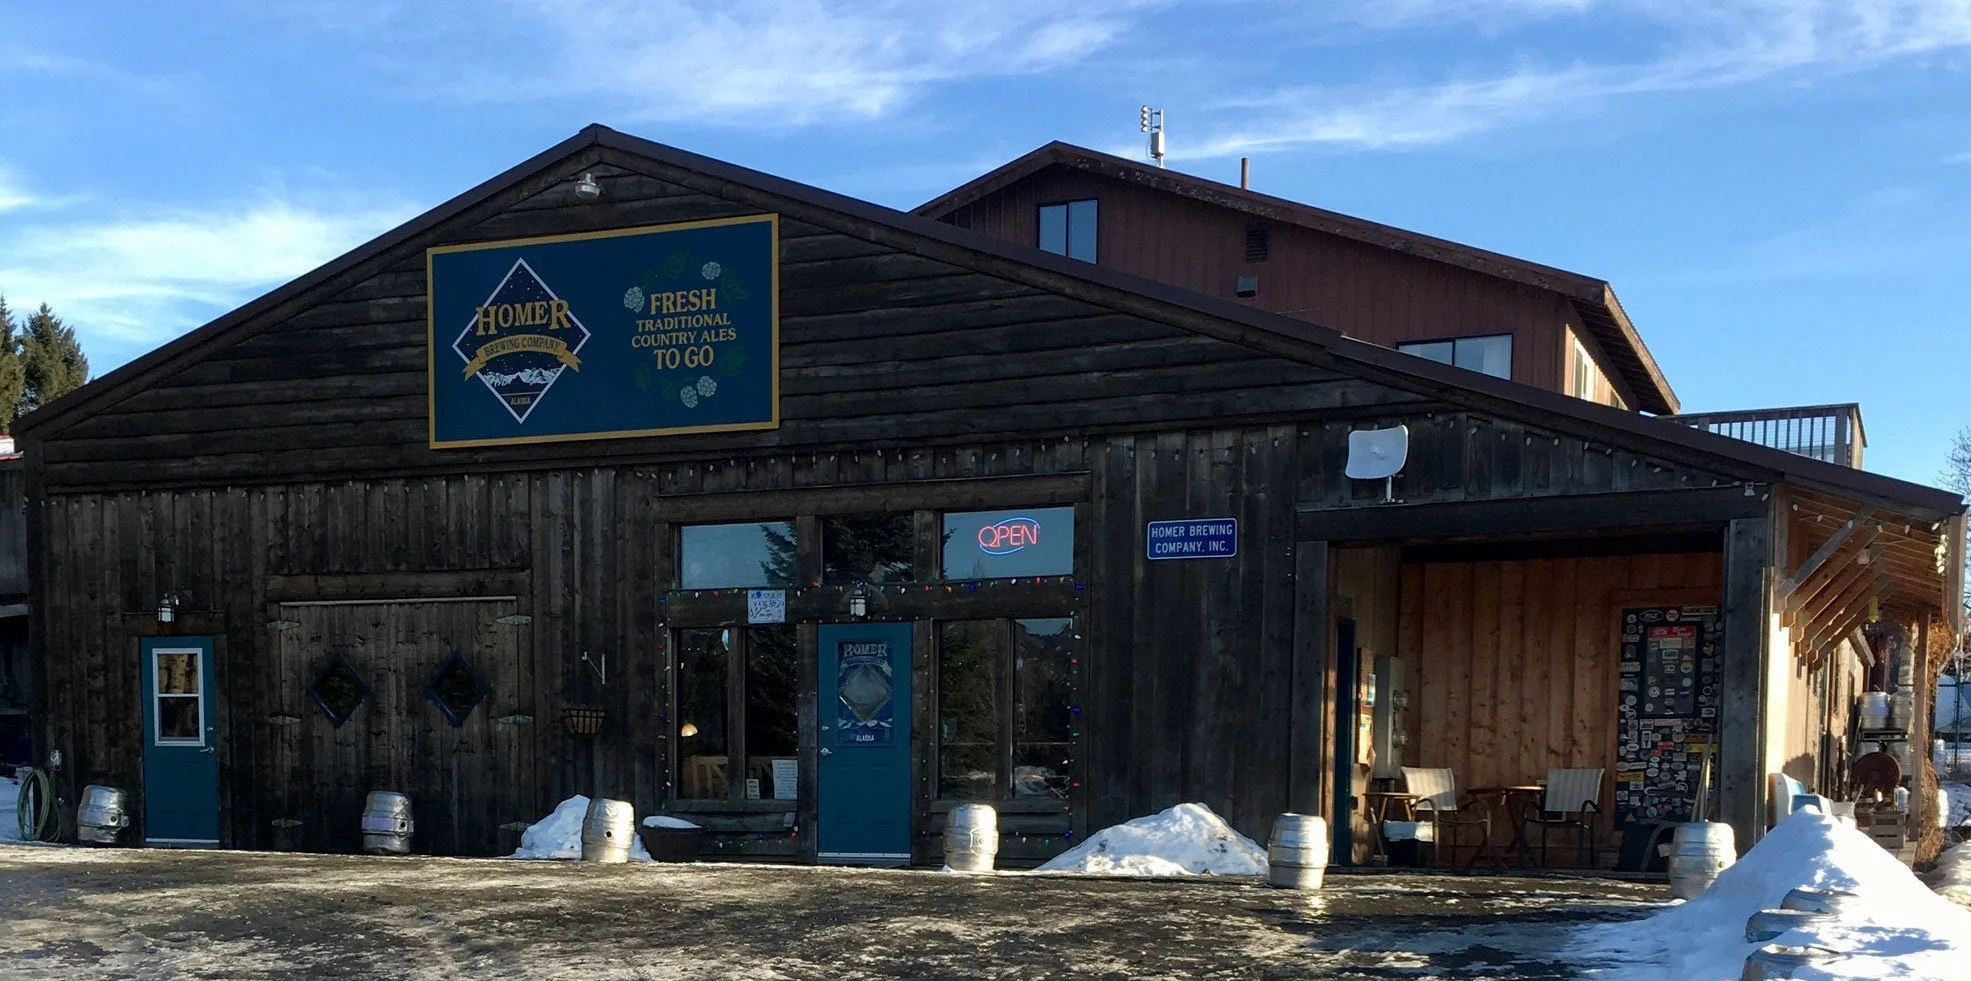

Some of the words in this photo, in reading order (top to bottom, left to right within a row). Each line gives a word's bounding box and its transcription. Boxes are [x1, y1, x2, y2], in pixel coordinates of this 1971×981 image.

[650, 288, 716, 315] FRESH
[475, 299, 571, 336] HOMER
[636, 312, 731, 332] TRADITIONAL
[484, 340, 520, 358] BREWING
[521, 336, 561, 351] COMPANY
[631, 331, 697, 348] COUNTRY
[700, 327, 737, 343] ALES
[653, 347, 681, 370] TO
[684, 345, 715, 368] GO
[510, 396, 531, 405] ALASKA
[978, 524, 1037, 548] OPEN
[1151, 526, 1186, 538] HOMER
[1189, 524, 1233, 537] BREWING
[1208, 540, 1229, 552] INC.
[855, 734, 875, 742] ALASKA
